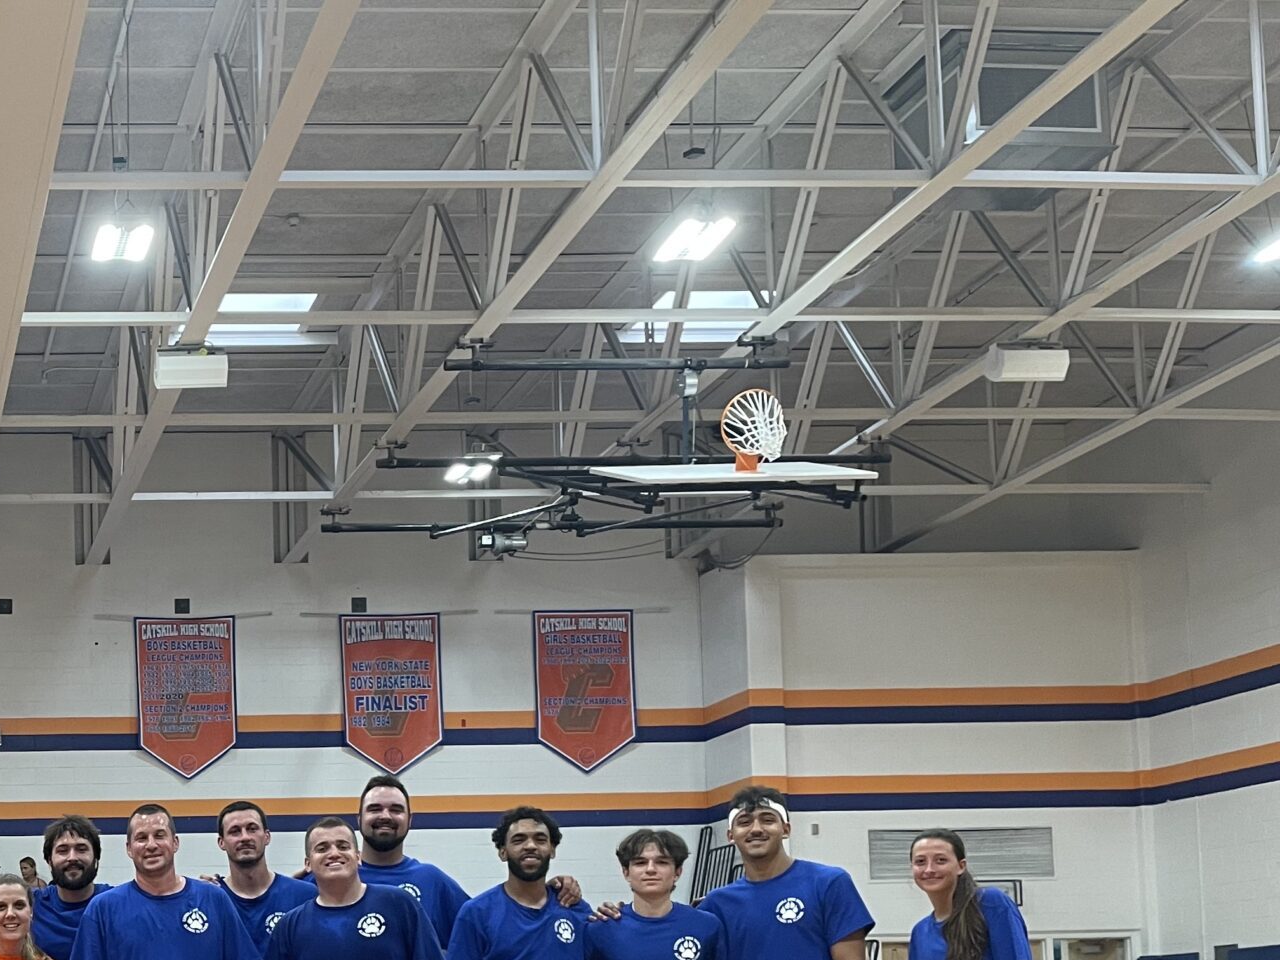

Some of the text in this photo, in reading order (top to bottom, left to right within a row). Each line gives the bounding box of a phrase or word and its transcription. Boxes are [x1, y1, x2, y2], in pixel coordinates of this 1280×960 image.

[540, 617, 628, 634] CATSKILL HIGH SCHOOL
[142, 624, 230, 640] CATSKILL HIGH SCHOOL
[346, 620, 434, 644] CATSKILL HIGH SCHOOL
[544, 633, 622, 644] GIRLS BASKETBALL
[146, 640, 224, 652] BOYS BASKETBALL
[546, 646, 623, 656] LEAGUE CHAMPIONS
[147, 653, 224, 662] LEAGUE CHAMPIONS
[352, 660, 430, 672] NEW YORK STATE
[350, 674, 432, 690] BOYS BASKETBALL
[354, 694, 429, 713] FINALIST
[544, 698, 576, 706] SECTION
[584, 697, 628, 706] CHAMPIONS
[144, 705, 177, 714] SECTION
[186, 704, 229, 712] CHAMPIONS
[350, 715, 392, 728] 1982 1984
